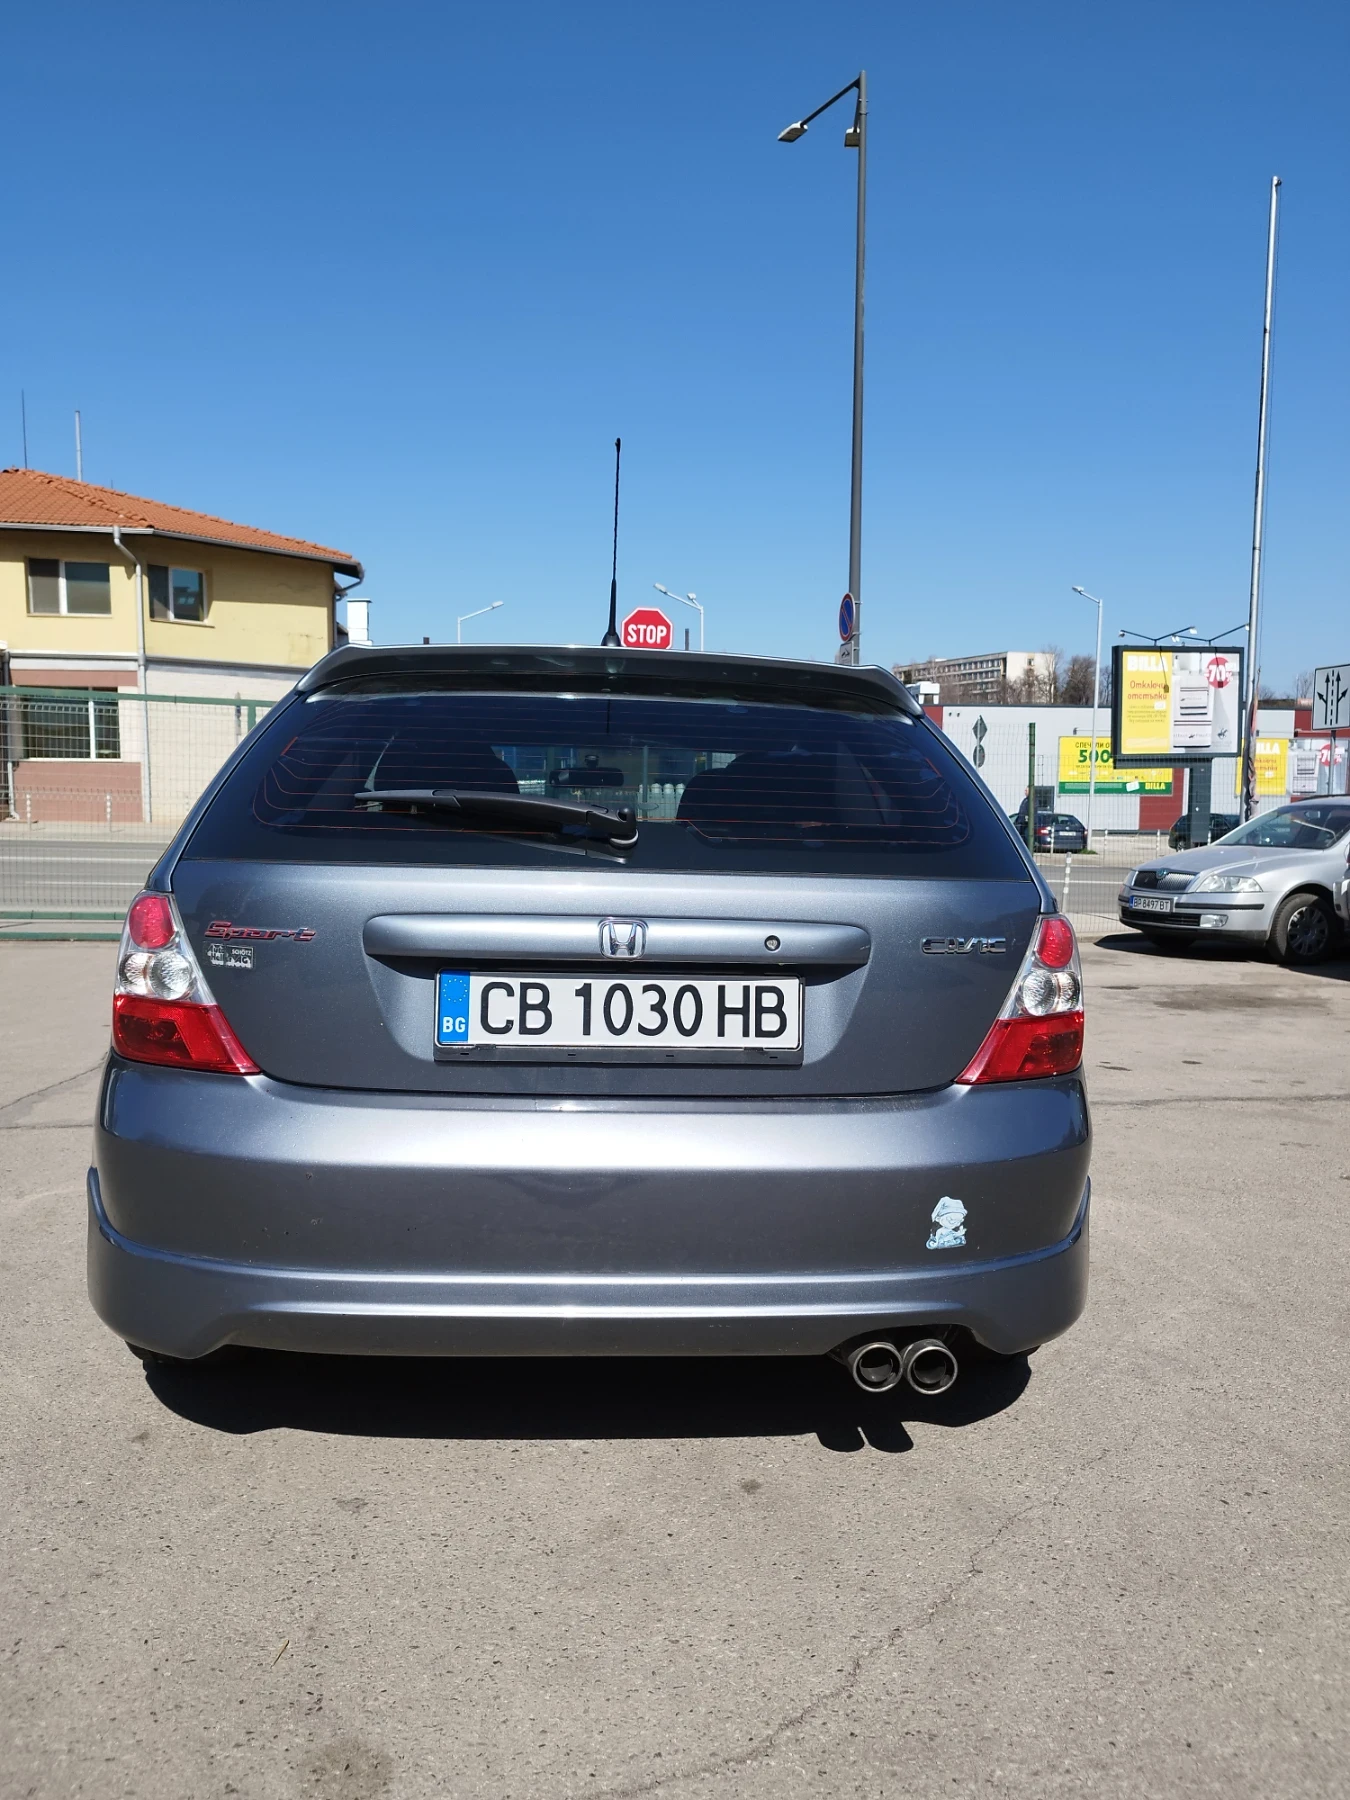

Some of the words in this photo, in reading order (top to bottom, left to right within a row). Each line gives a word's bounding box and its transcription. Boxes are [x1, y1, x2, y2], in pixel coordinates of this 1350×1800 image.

[627, 624, 667, 644] STOP
[1127, 655, 1168, 671] BILLA
[1255, 742, 1280, 754] ILLA
[1145, 782, 1166, 790] BILLA
[1142, 899, 1158, 909] 8497
[205, 920, 316, 941] Sport
[922, 937, 1006, 954] CIVIC
[480, 982, 553, 1035] CB
[575, 982, 703, 1037] 1030
[717, 984, 787, 1038] HB
[443, 1018, 466, 1033] BG
